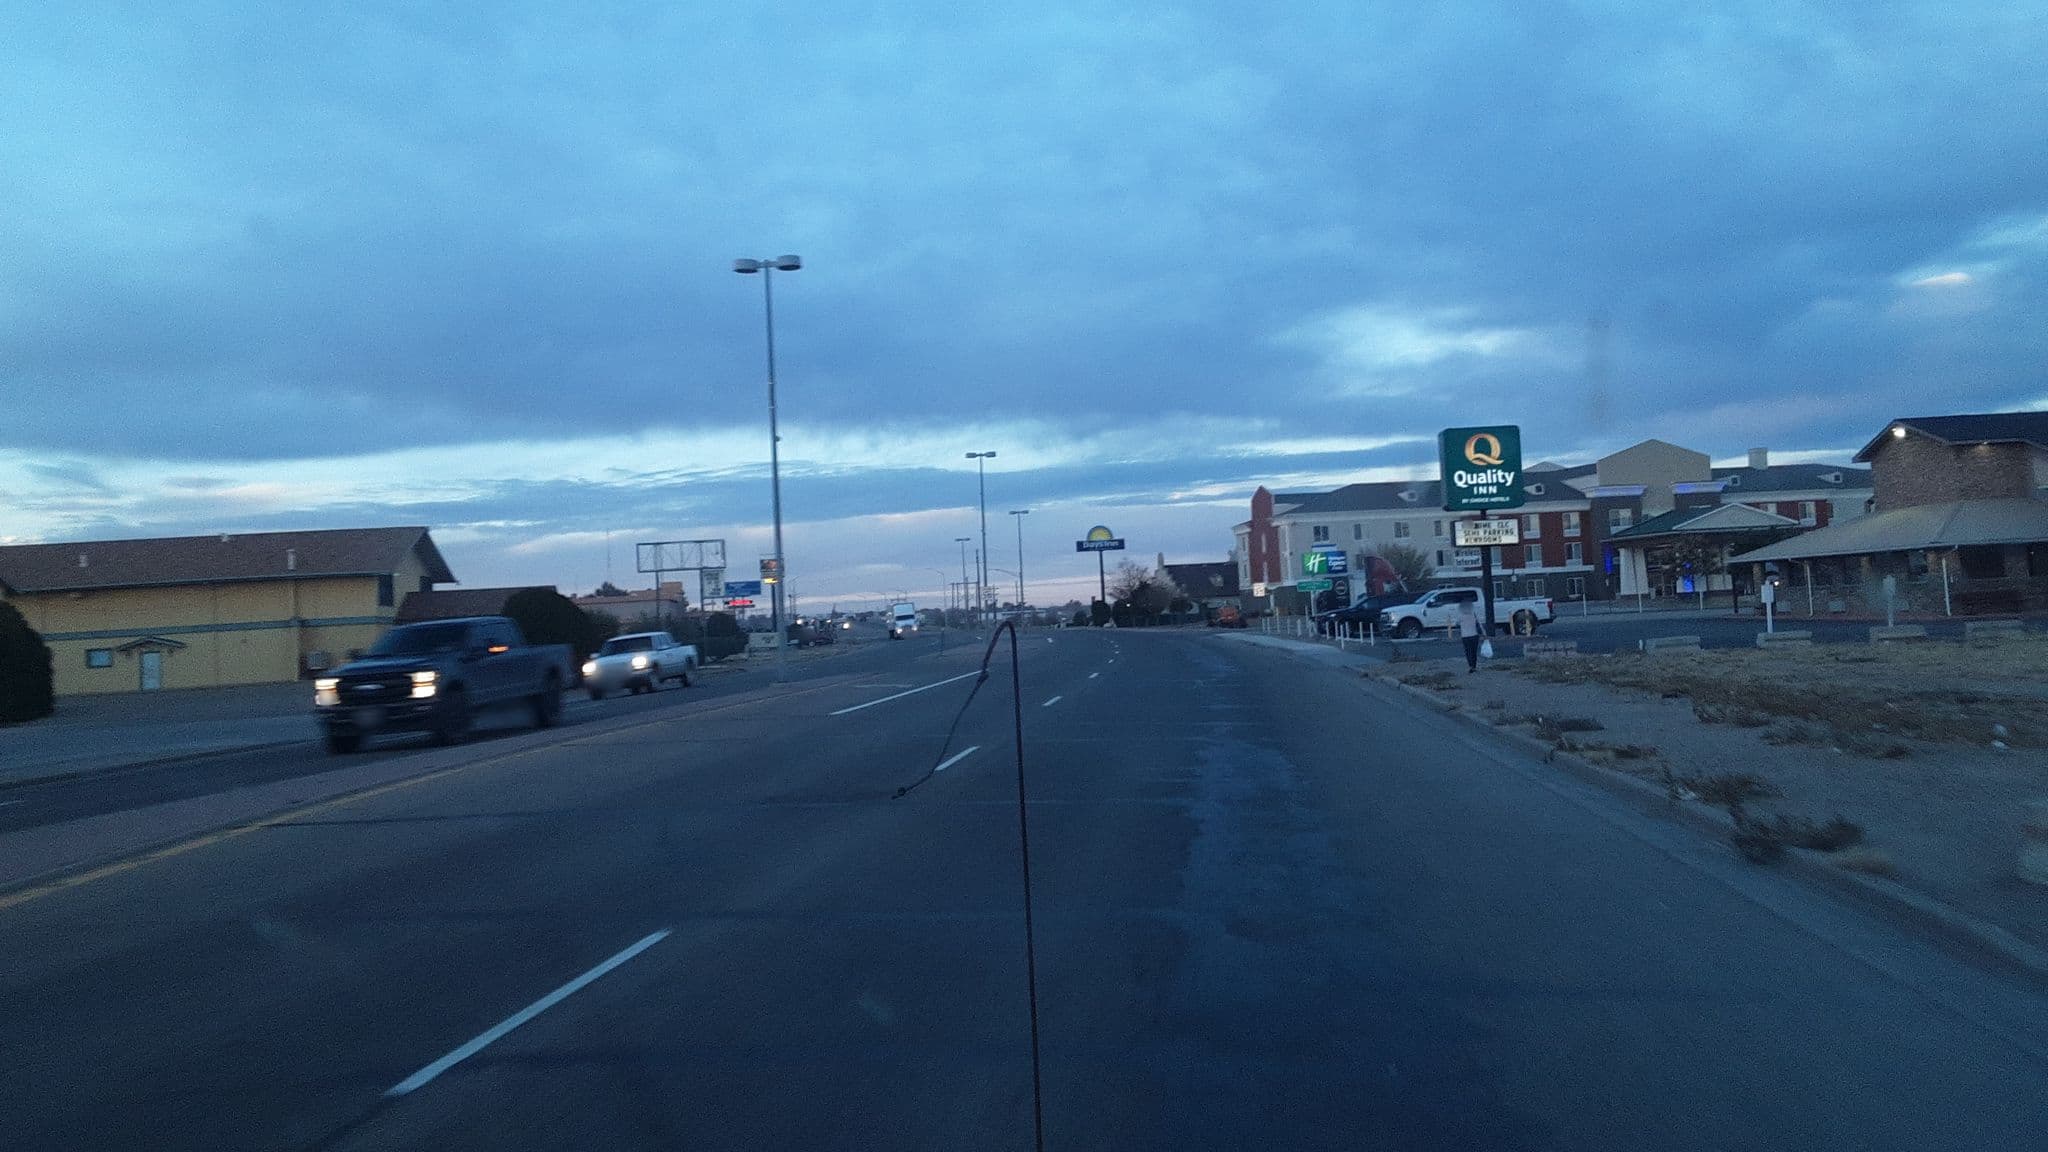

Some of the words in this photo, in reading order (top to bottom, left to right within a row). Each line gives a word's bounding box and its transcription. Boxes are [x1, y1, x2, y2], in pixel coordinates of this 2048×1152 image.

[1453, 469, 1515, 488] Quality
[1473, 485, 1498, 495] INN
[1483, 528, 1514, 536] PARKING
